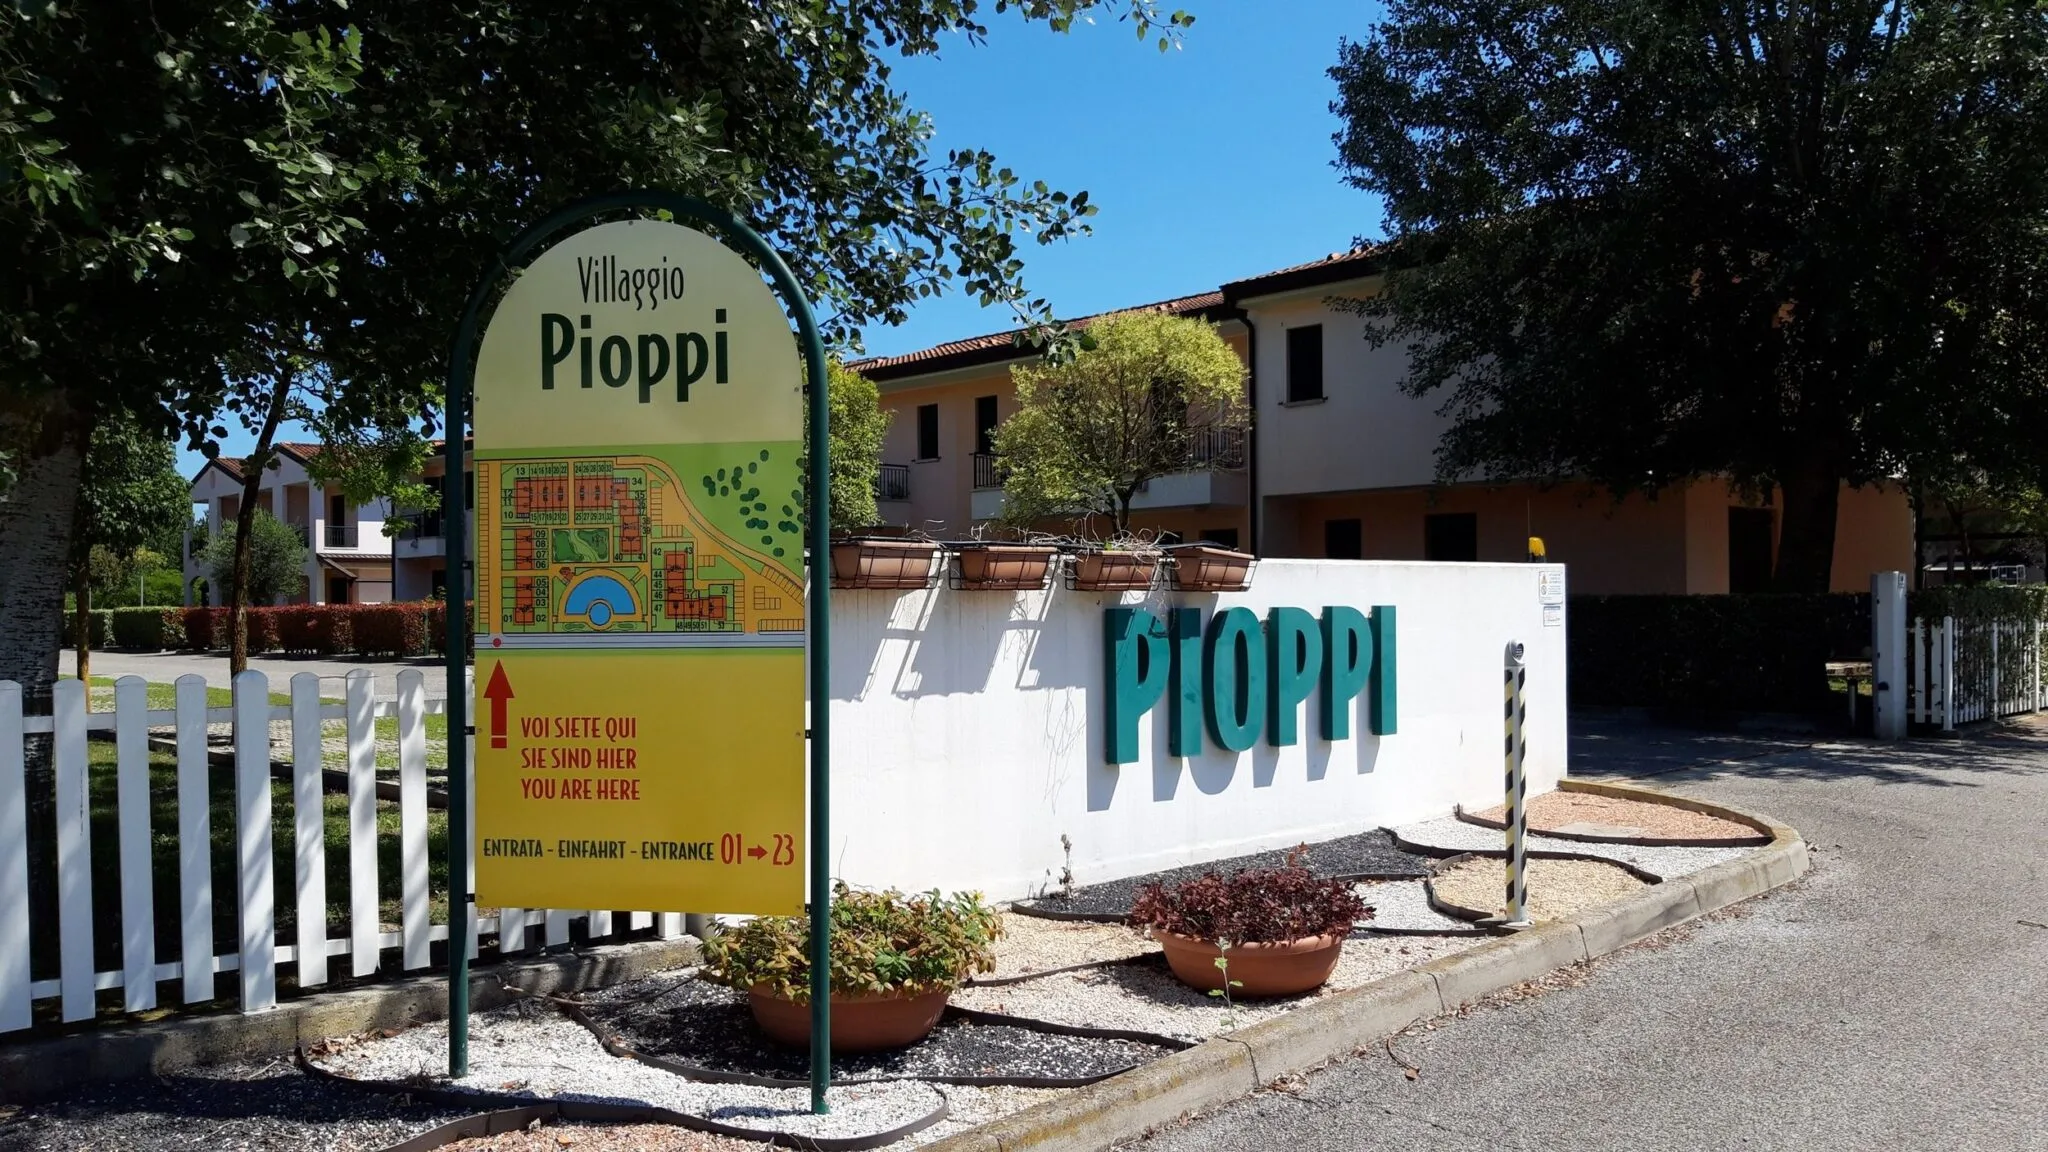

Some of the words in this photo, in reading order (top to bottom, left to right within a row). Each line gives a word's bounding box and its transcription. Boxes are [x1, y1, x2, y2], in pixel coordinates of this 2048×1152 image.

[577, 255, 684, 311] Villaggio
[541, 308, 728, 404] Pioppi
[516, 467, 525, 475] 13
[575, 465, 582, 473] 24
[631, 477, 642, 485] 34
[504, 489, 512, 498] 12
[504, 497, 512, 506] 11
[504, 511, 513, 519] 10
[575, 512, 582, 520] 25
[583, 512, 589, 520] 27
[590, 512, 597, 520] 29
[535, 530, 546, 538] 09
[535, 540, 546, 548] 08
[535, 551, 546, 559] 07
[653, 548, 662, 556] 42
[684, 547, 694, 555] 43
[535, 561, 546, 569] 06
[535, 578, 547, 587] 05
[535, 588, 546, 597] 04
[721, 586, 729, 594] 52
[653, 604, 663, 612] 47
[504, 614, 513, 623] 01
[535, 614, 546, 623] 02
[692, 621, 699, 629] 50
[700, 621, 708, 629] 51
[718, 621, 725, 630] 53
[1105, 605, 1398, 764] PIOPPI
[521, 717, 550, 738] VOI
[554, 717, 601, 738] SIETE
[605, 717, 637, 742] QUI
[521, 748, 547, 769] SIE
[551, 748, 592, 769] SIND
[596, 748, 637, 770] HIER
[521, 778, 556, 800] YOU
[561, 778, 592, 800] ARE
[596, 778, 640, 801] HERE
[483, 838, 544, 857] ENTRATA
[558, 840, 627, 859] EINFAHRT
[641, 841, 715, 861] ENTRANCE
[720, 832, 743, 865] 01
[771, 833, 796, 867] 23
